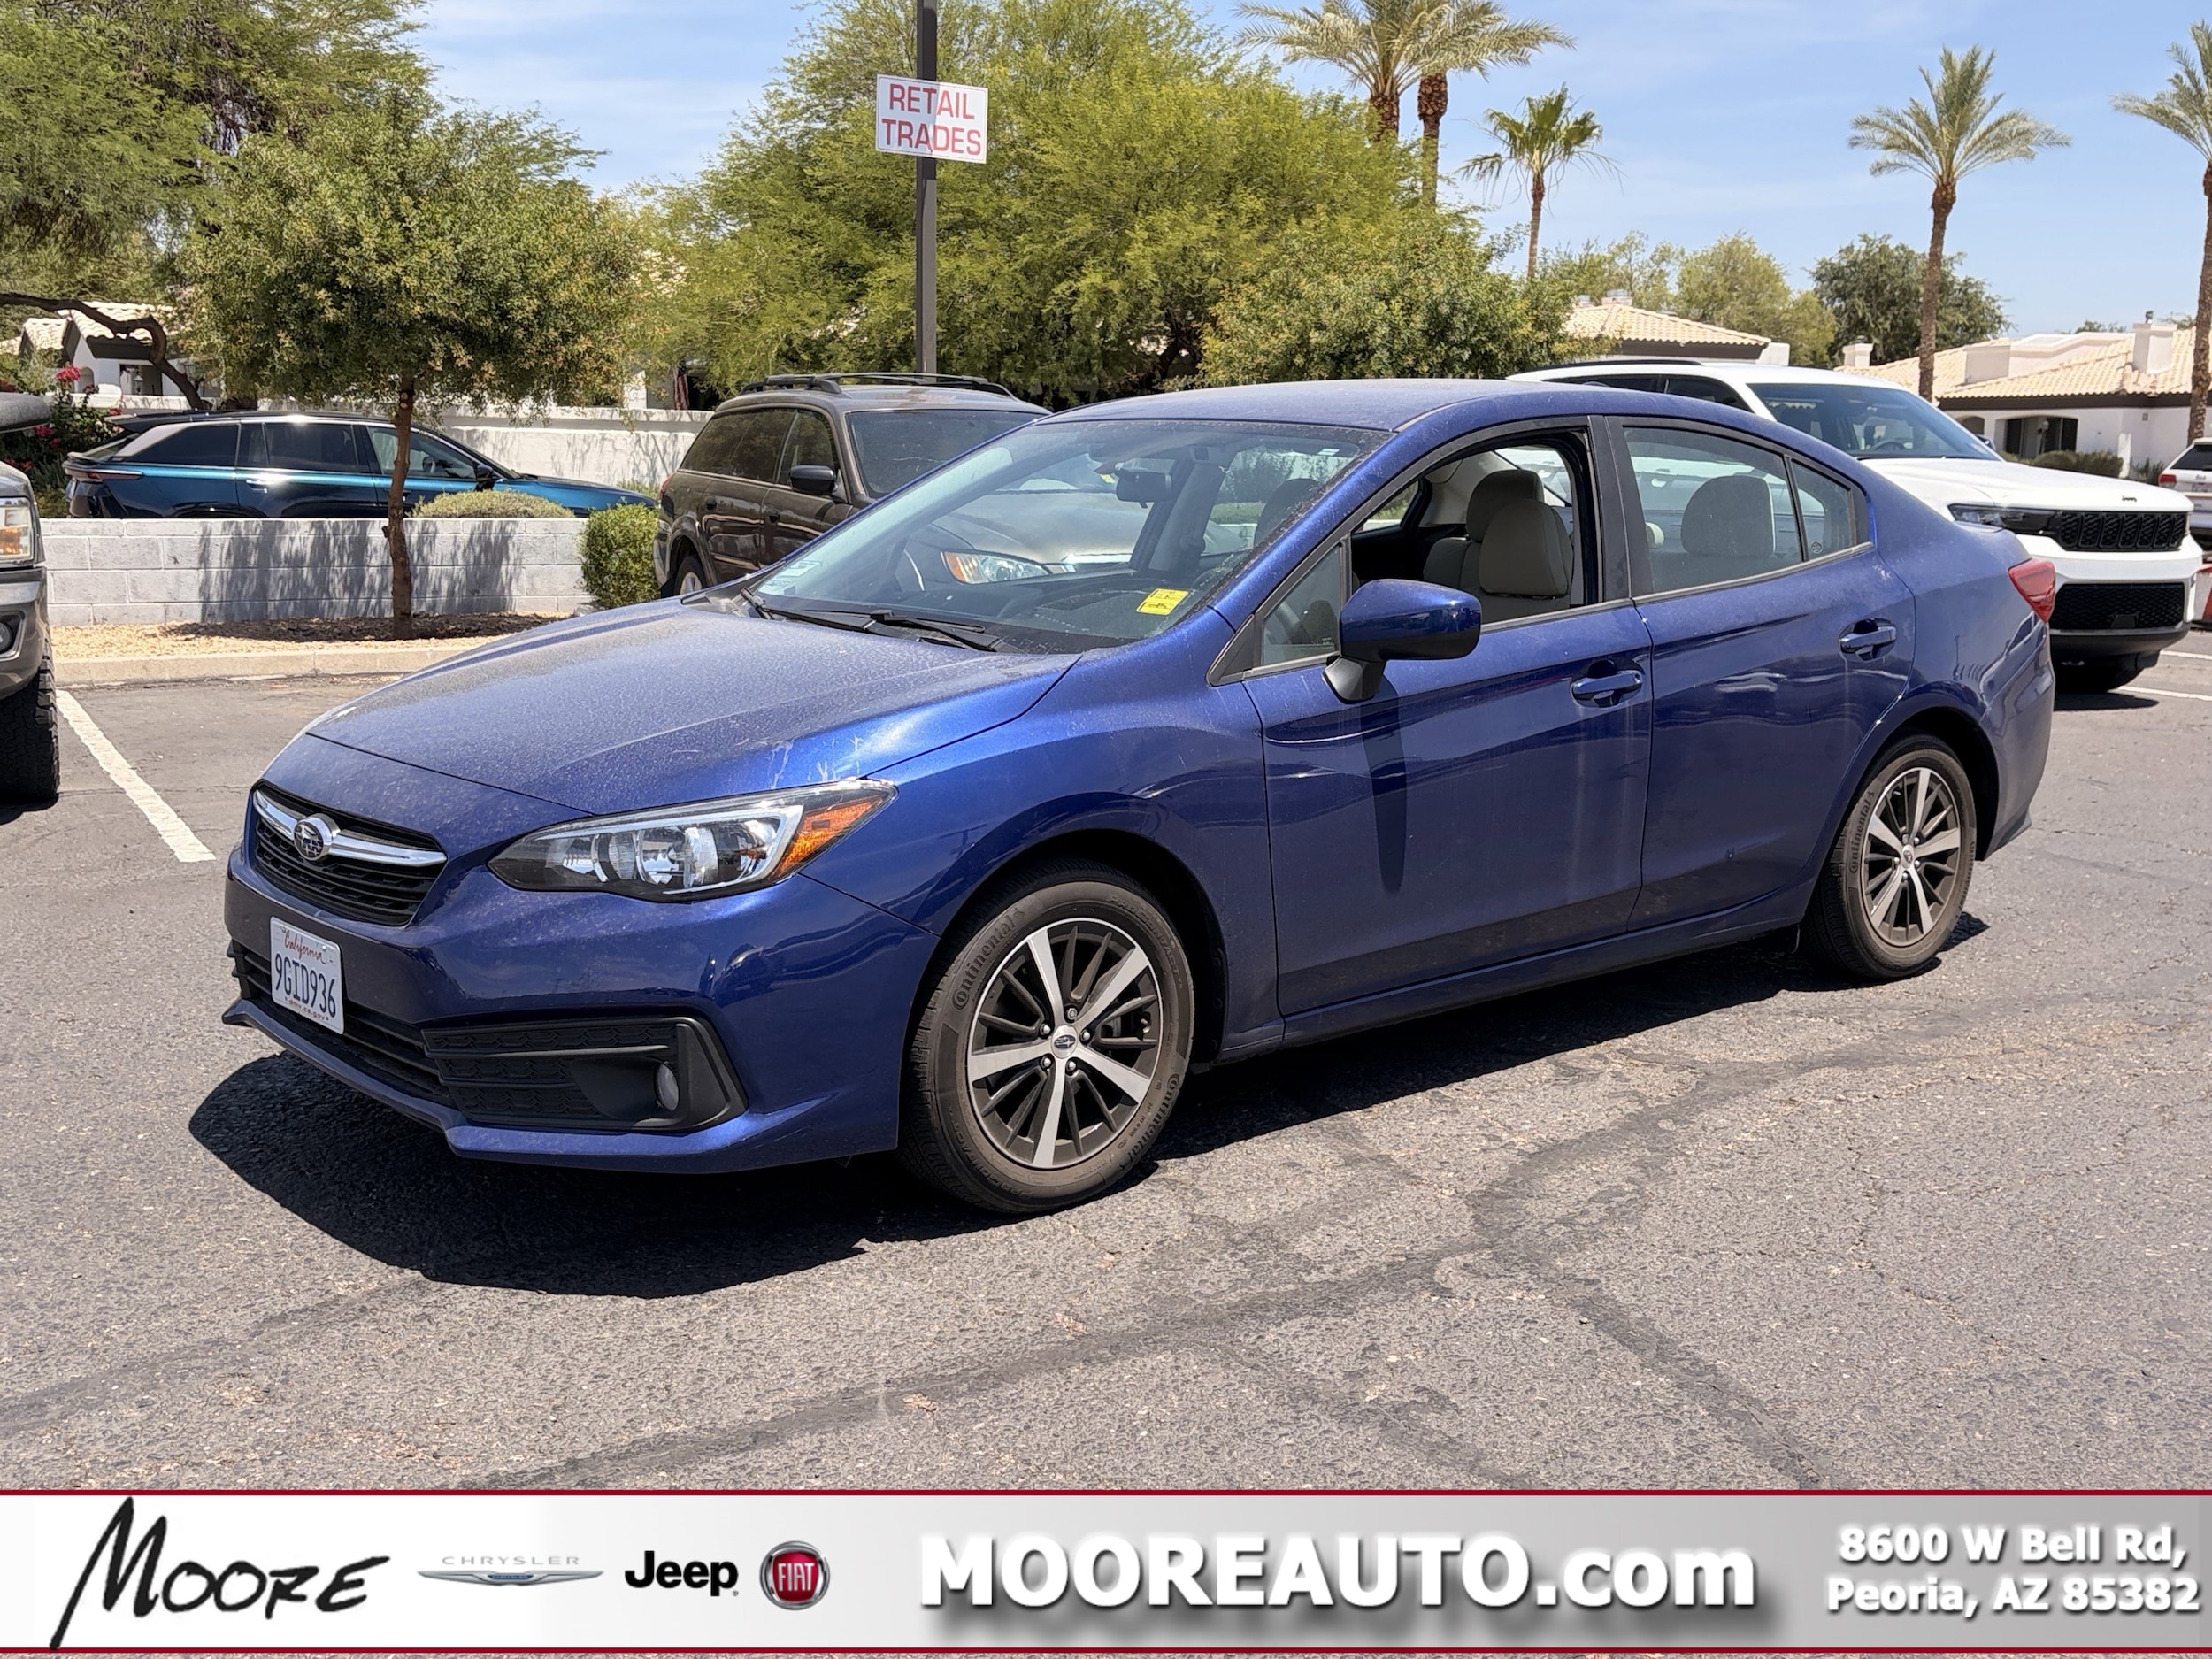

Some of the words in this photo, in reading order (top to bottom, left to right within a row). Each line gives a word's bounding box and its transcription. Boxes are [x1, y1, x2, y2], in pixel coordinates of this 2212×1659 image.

[889, 83, 975, 119] RETAIL
[882, 119, 981, 156] TRADES
[282, 927, 327, 965] California
[952, 914, 1017, 1010] Continental
[275, 953, 336, 1018] 9GID936
